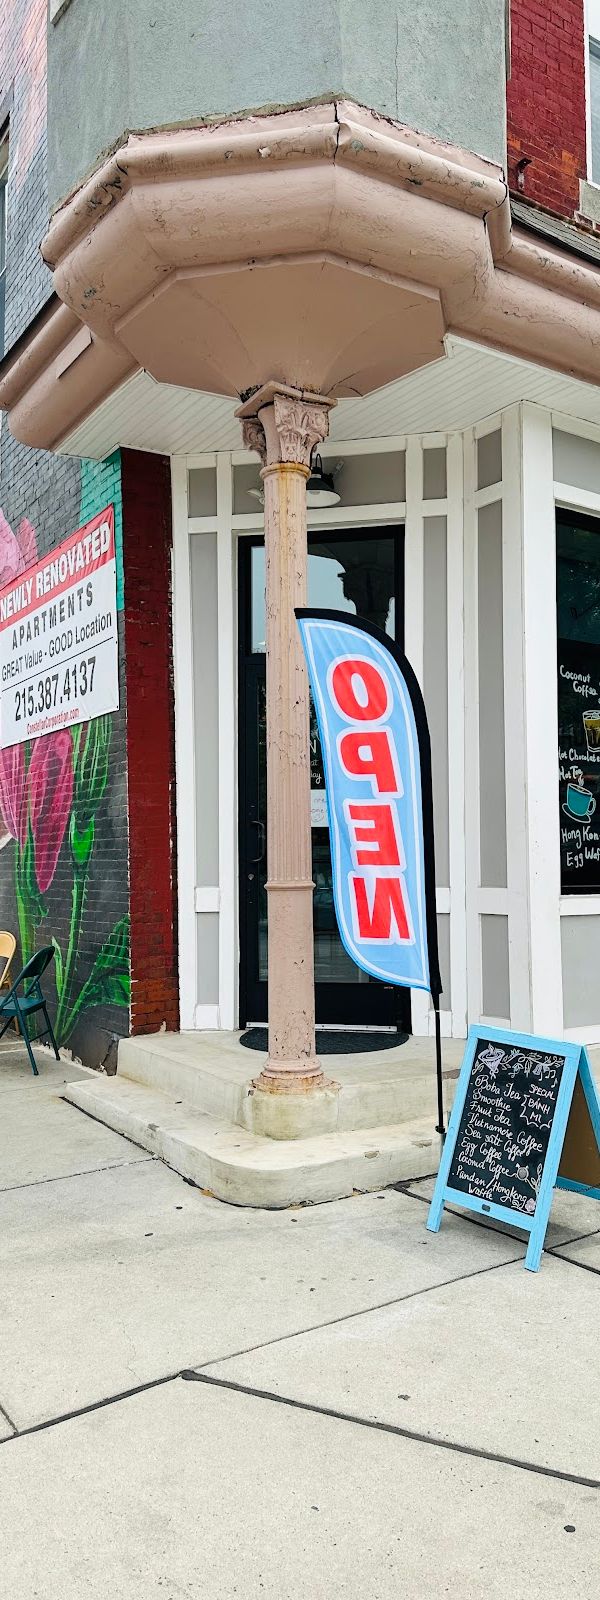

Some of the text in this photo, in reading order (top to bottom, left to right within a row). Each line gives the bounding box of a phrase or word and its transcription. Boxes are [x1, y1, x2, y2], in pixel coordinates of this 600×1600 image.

[0, 521, 110, 621] NEWLY RENOVATED
[12, 582, 93, 650] APARTMENTS
[2, 656, 23, 681] GREAT
[24, 649, 43, 669] Value
[49, 629, 73, 658] GOOD
[75, 612, 112, 644] Location
[560, 664, 591, 683] Coconut
[15, 656, 96, 721] 215.387.4137
[561, 828, 582, 849] Hong
[566, 852, 583, 868] Egg
[473, 1088, 512, 1111] Smoothie
[475, 1075, 521, 1100] Boba Tea
[529, 1084, 555, 1100] SPECIAL
[470, 1101, 511, 1126] Fruit Tea
[465, 1124, 482, 1139] Sea
[517, 1131, 543, 1156] Coffee
[461, 1137, 502, 1162] Egg Coffee
[456, 1165, 486, 1186] Pandan
